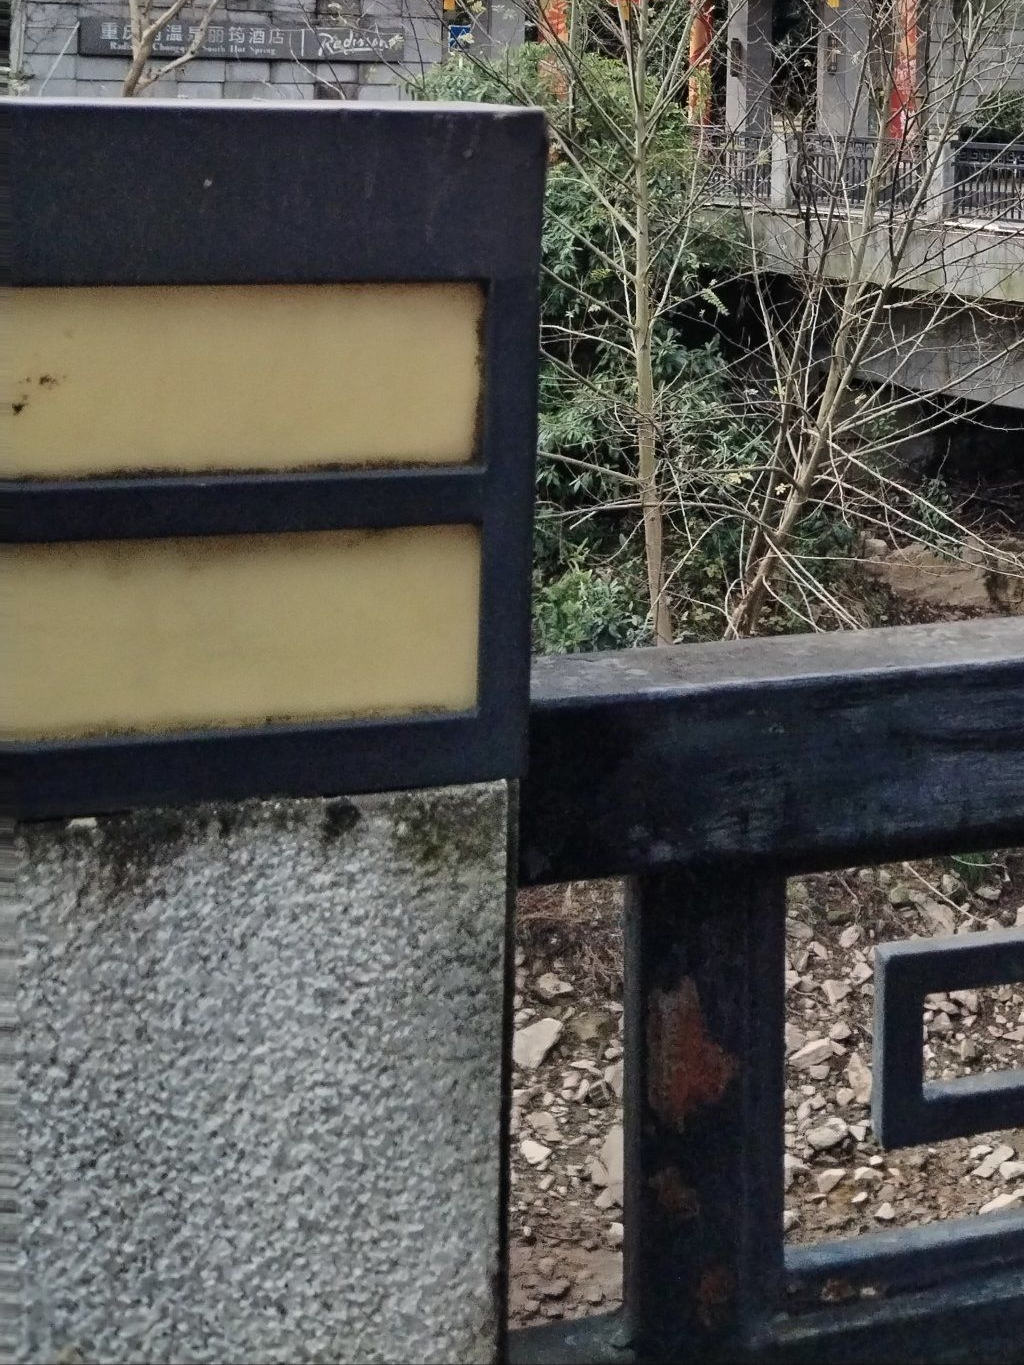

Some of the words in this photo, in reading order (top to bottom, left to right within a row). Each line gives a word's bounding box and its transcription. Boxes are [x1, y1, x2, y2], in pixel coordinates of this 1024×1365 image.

[100, 21, 284, 44] 重庆温泉丽筠酒店
[230, 45, 245, 53] Hot
